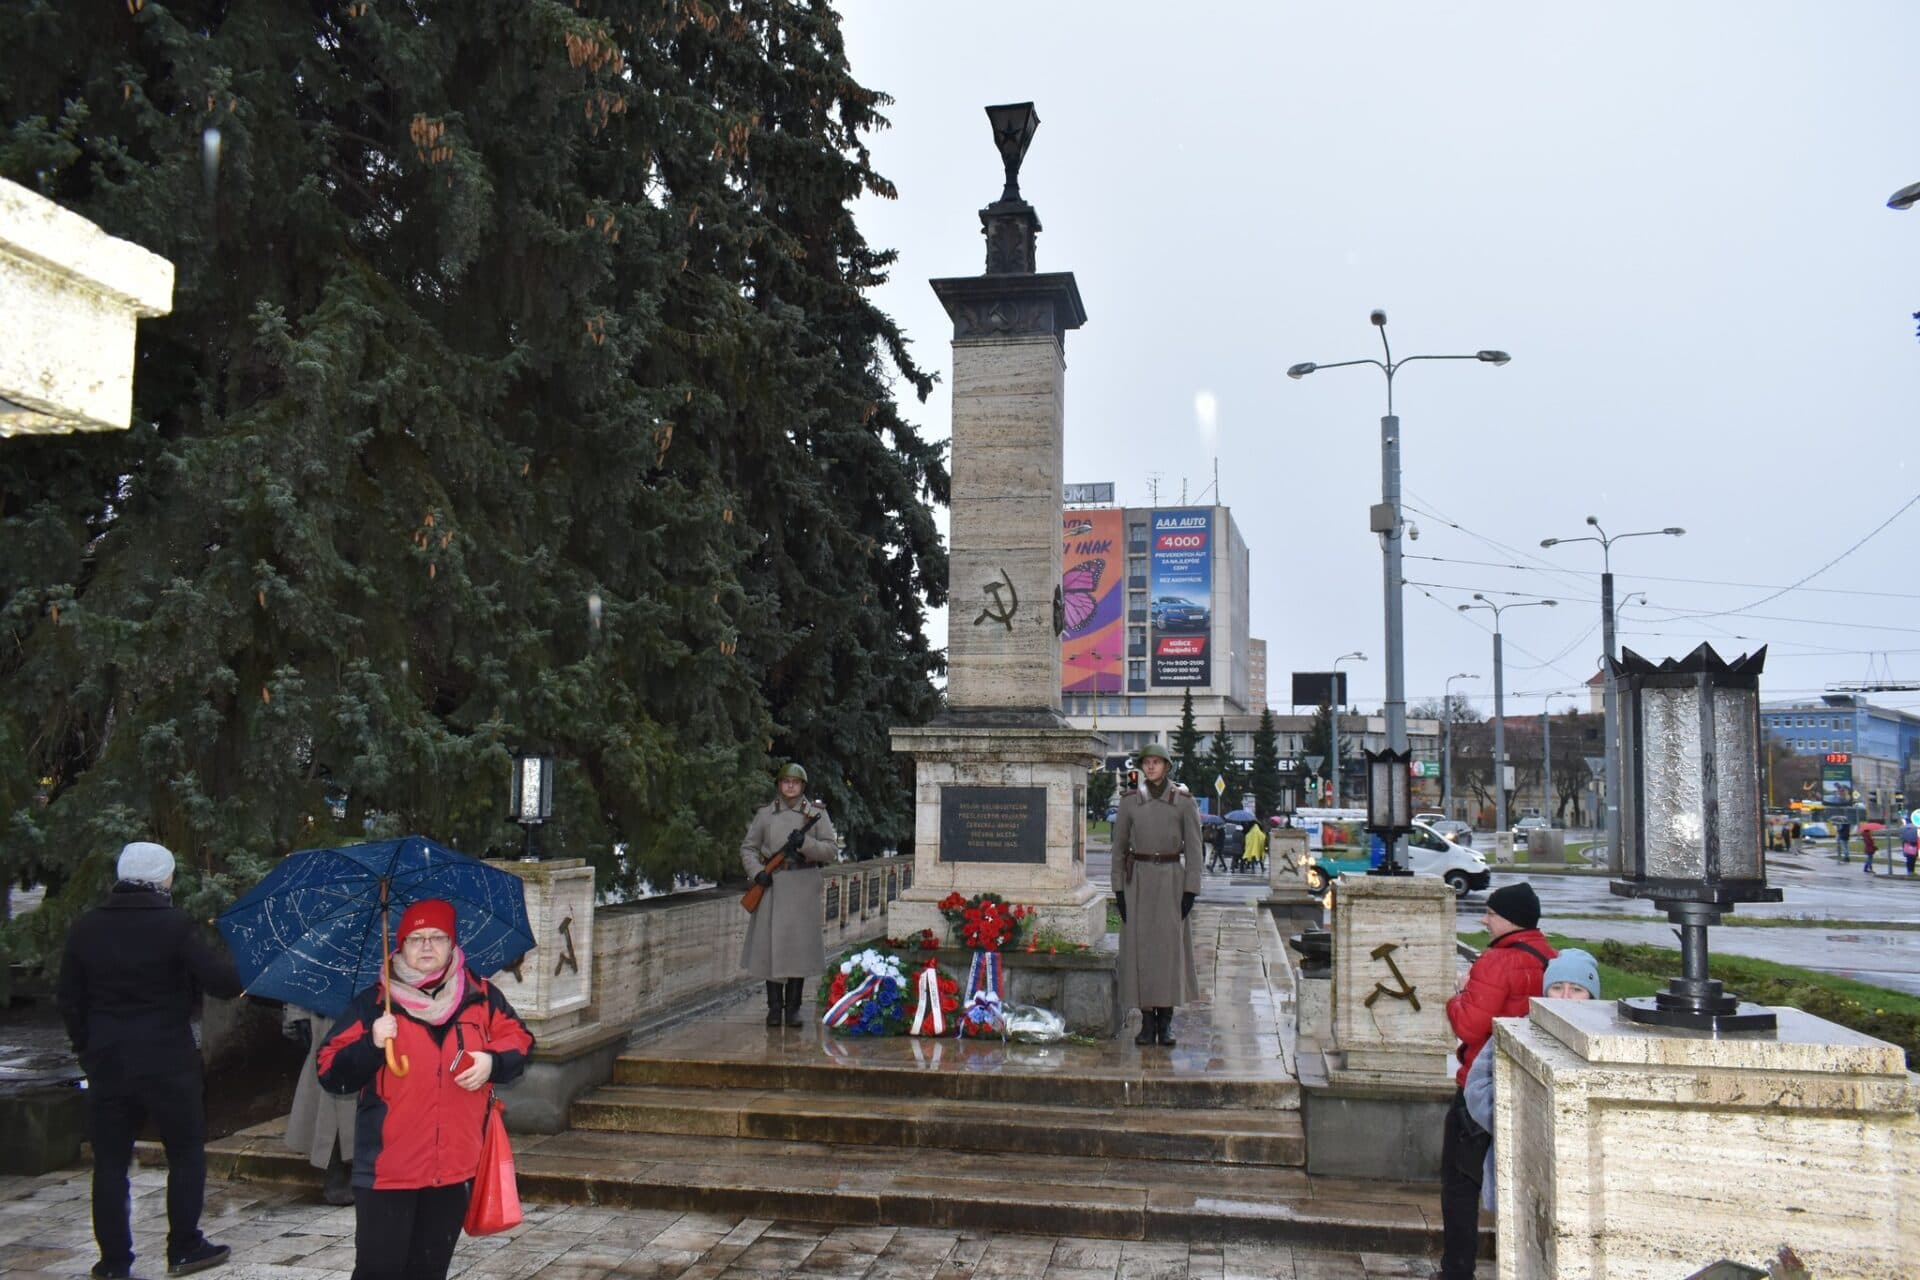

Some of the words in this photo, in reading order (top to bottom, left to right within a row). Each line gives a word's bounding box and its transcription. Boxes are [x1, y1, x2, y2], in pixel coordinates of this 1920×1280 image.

[1156, 518, 1177, 527] AAA
[1179, 517, 1206, 526] AUTO
[1076, 539, 1112, 554] INAK
